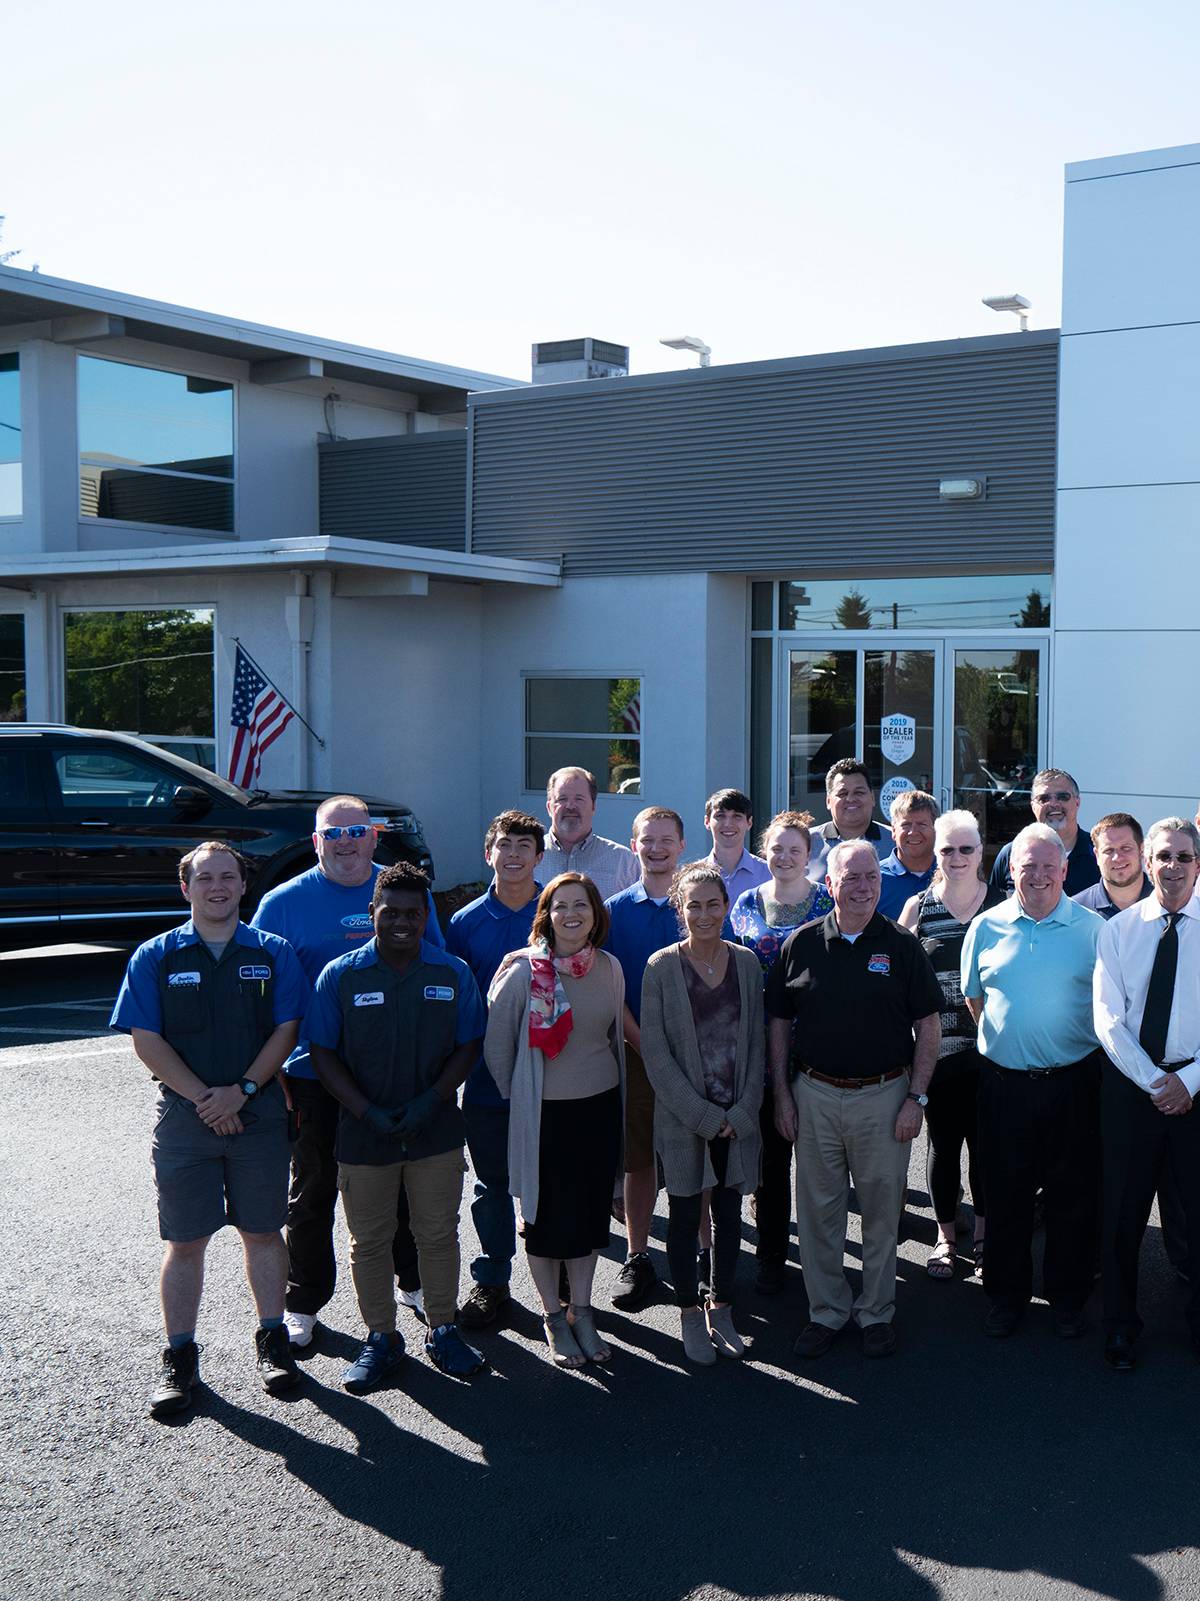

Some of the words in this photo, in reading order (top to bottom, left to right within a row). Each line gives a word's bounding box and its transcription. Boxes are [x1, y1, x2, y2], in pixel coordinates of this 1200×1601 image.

[889, 718, 907, 726] 2019
[883, 727, 914, 736] DEALER
[891, 780, 908, 788] 2019
